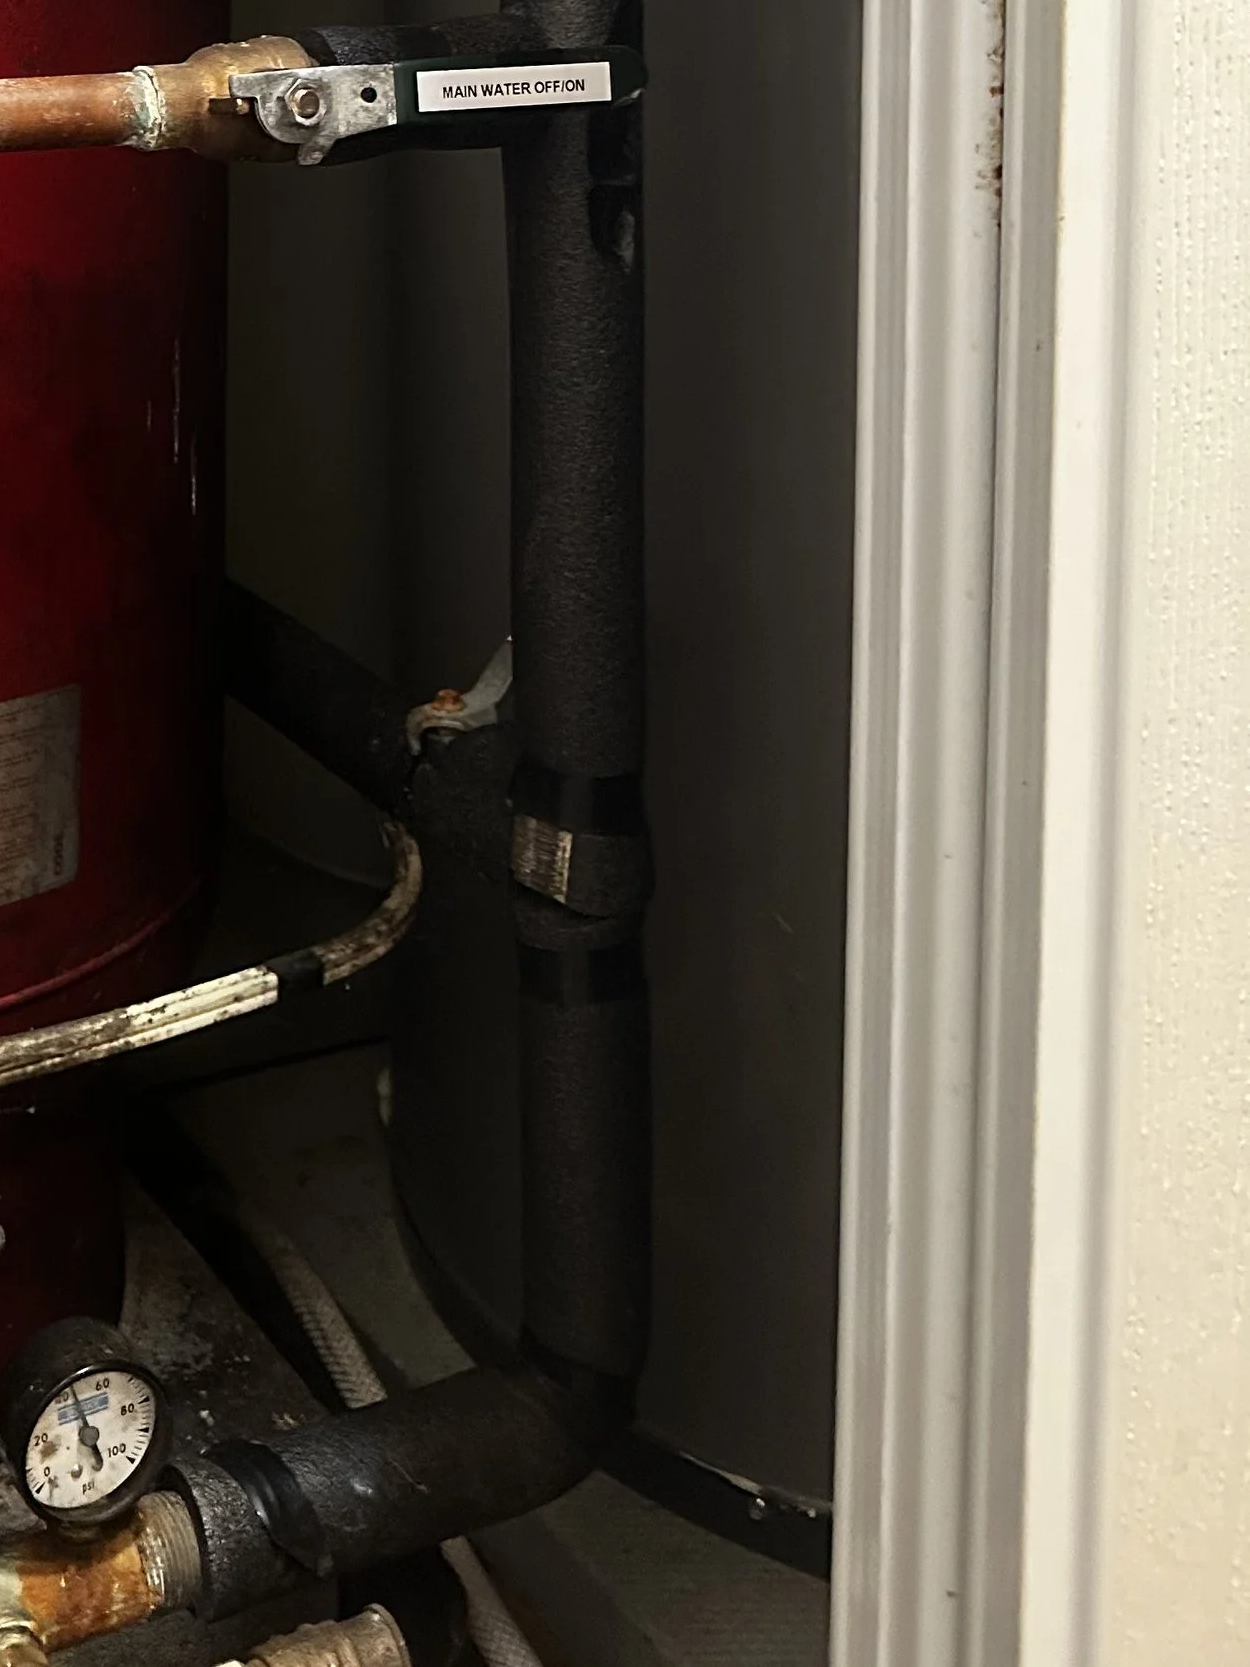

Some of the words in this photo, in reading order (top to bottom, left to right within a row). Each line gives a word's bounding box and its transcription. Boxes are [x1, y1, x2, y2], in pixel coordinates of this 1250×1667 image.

[442, 85, 477, 99] MAIN
[481, 82, 532, 97] WATER
[535, 78, 585, 94] OFF/ON
[95, 1377, 110, 1391] 60
[120, 1402, 135, 1416] 80
[33, 1433, 49, 1447] 20
[107, 1443, 127, 1458] 100
[43, 1466, 51, 1477] 0
[82, 1480, 95, 1495] psi
